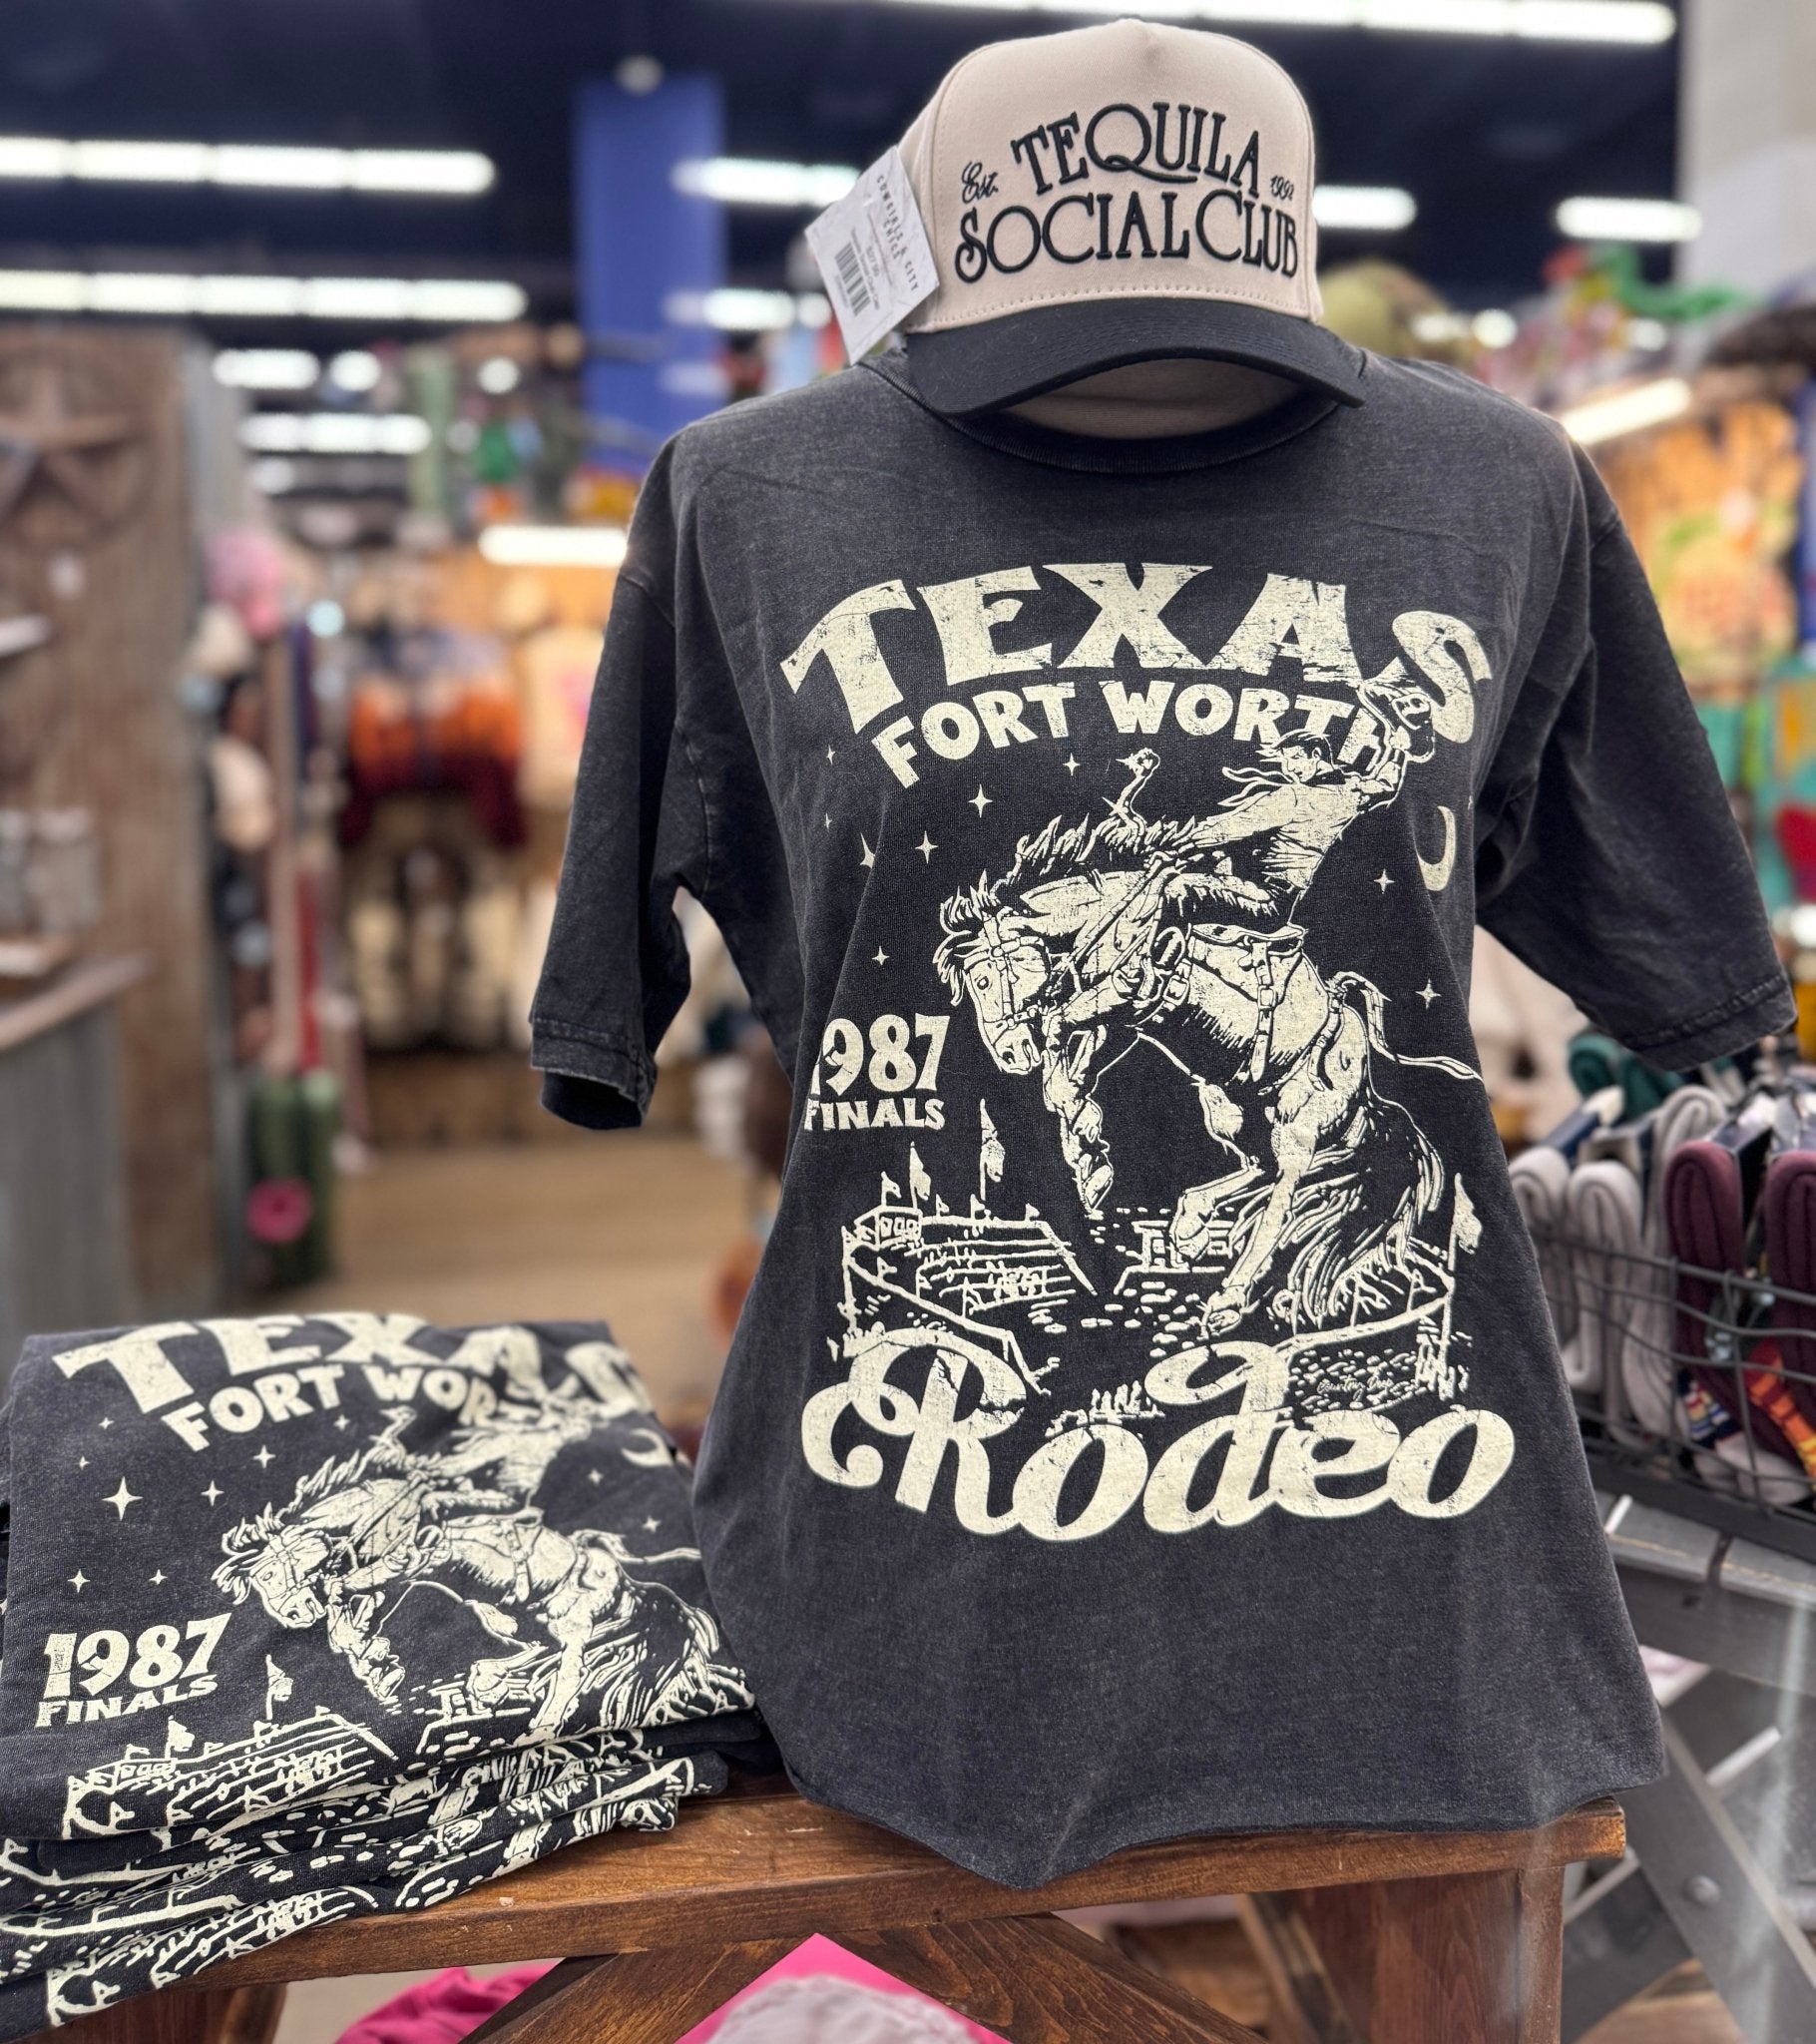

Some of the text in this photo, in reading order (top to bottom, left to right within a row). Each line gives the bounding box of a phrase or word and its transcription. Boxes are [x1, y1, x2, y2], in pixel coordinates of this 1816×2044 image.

[961, 161, 999, 204] Est.
[1011, 102, 1259, 200] TEQUILA
[902, 258, 920, 293] CITY
[955, 192, 1190, 283] SOCIAL
[1195, 189, 1298, 278] CLUB
[780, 562, 1493, 744] TEXAS
[871, 681, 1383, 789] FORT WORTH
[804, 1097, 946, 1131] FINALS
[162, 1363, 345, 1452] FORT
[801, 1326, 1516, 1542] Rodeo
[43, 1612, 232, 1700] 1987
[34, 1674, 219, 1728] FINALS
